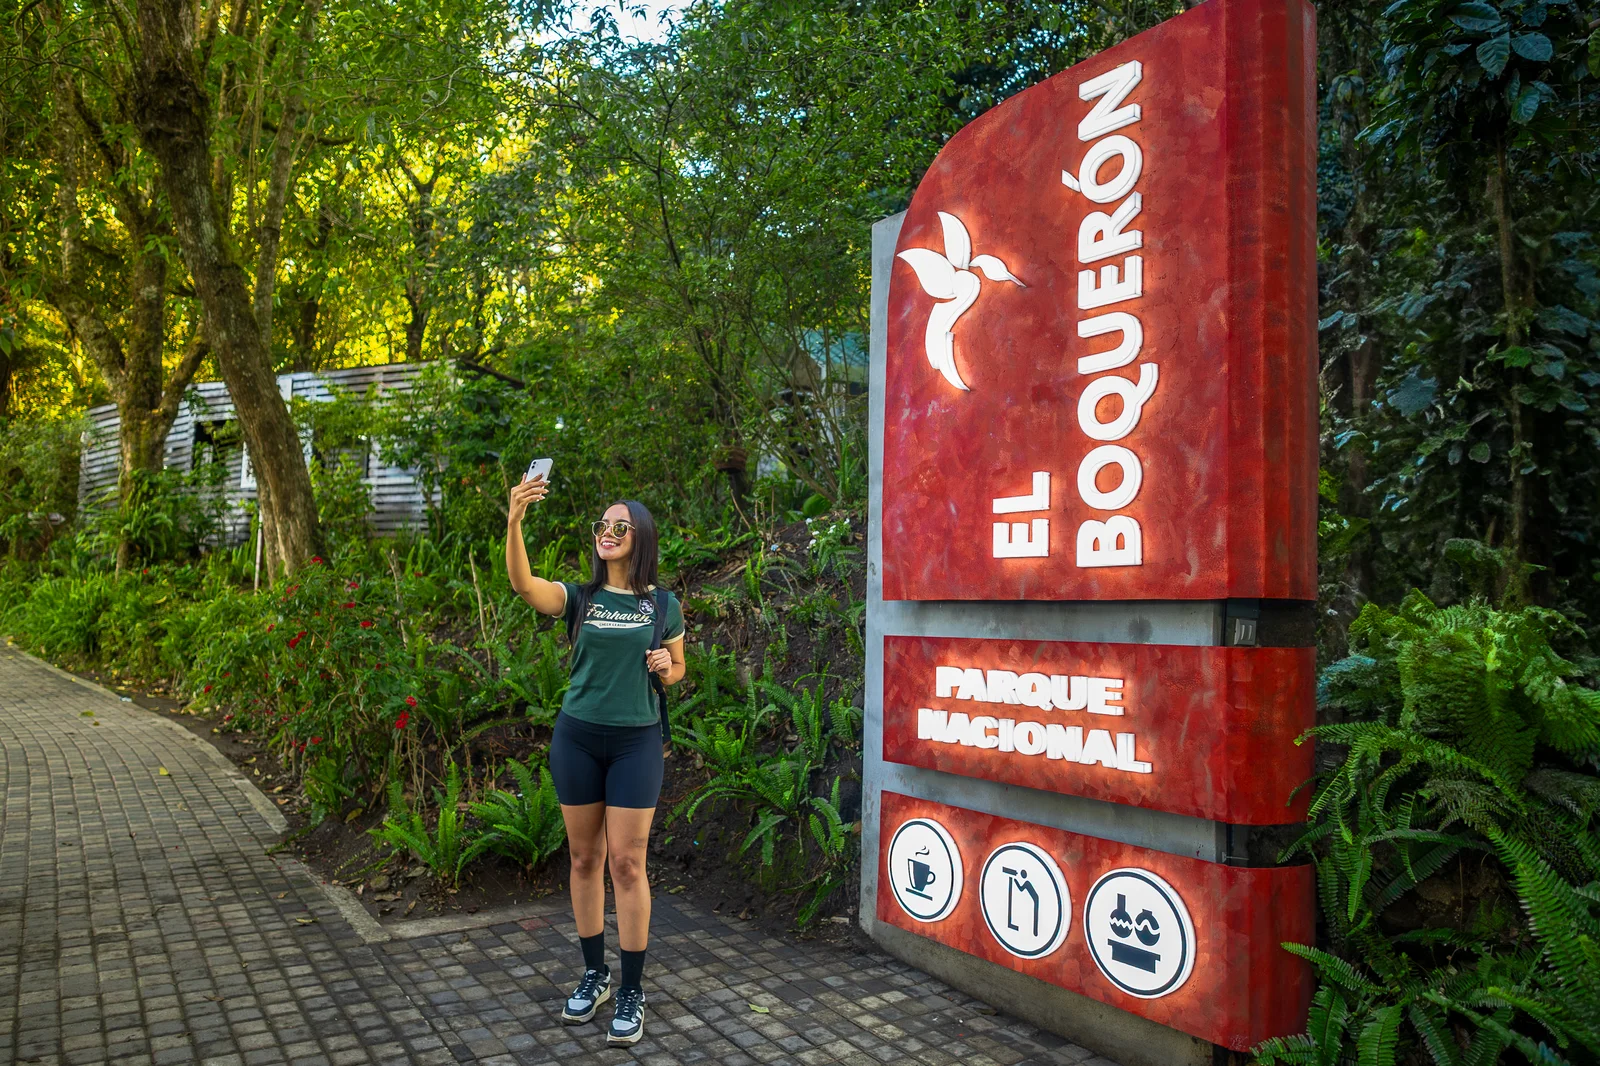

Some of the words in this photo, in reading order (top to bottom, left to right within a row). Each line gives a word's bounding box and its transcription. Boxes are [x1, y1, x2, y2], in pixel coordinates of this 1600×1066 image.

[1061, 59, 1158, 568] BOQUERÓN
[992, 471, 1051, 559] EL
[586, 602, 652, 624] Fairhaven
[935, 666, 1124, 716] PARQUE
[917, 708, 1153, 774] NACIONAL
